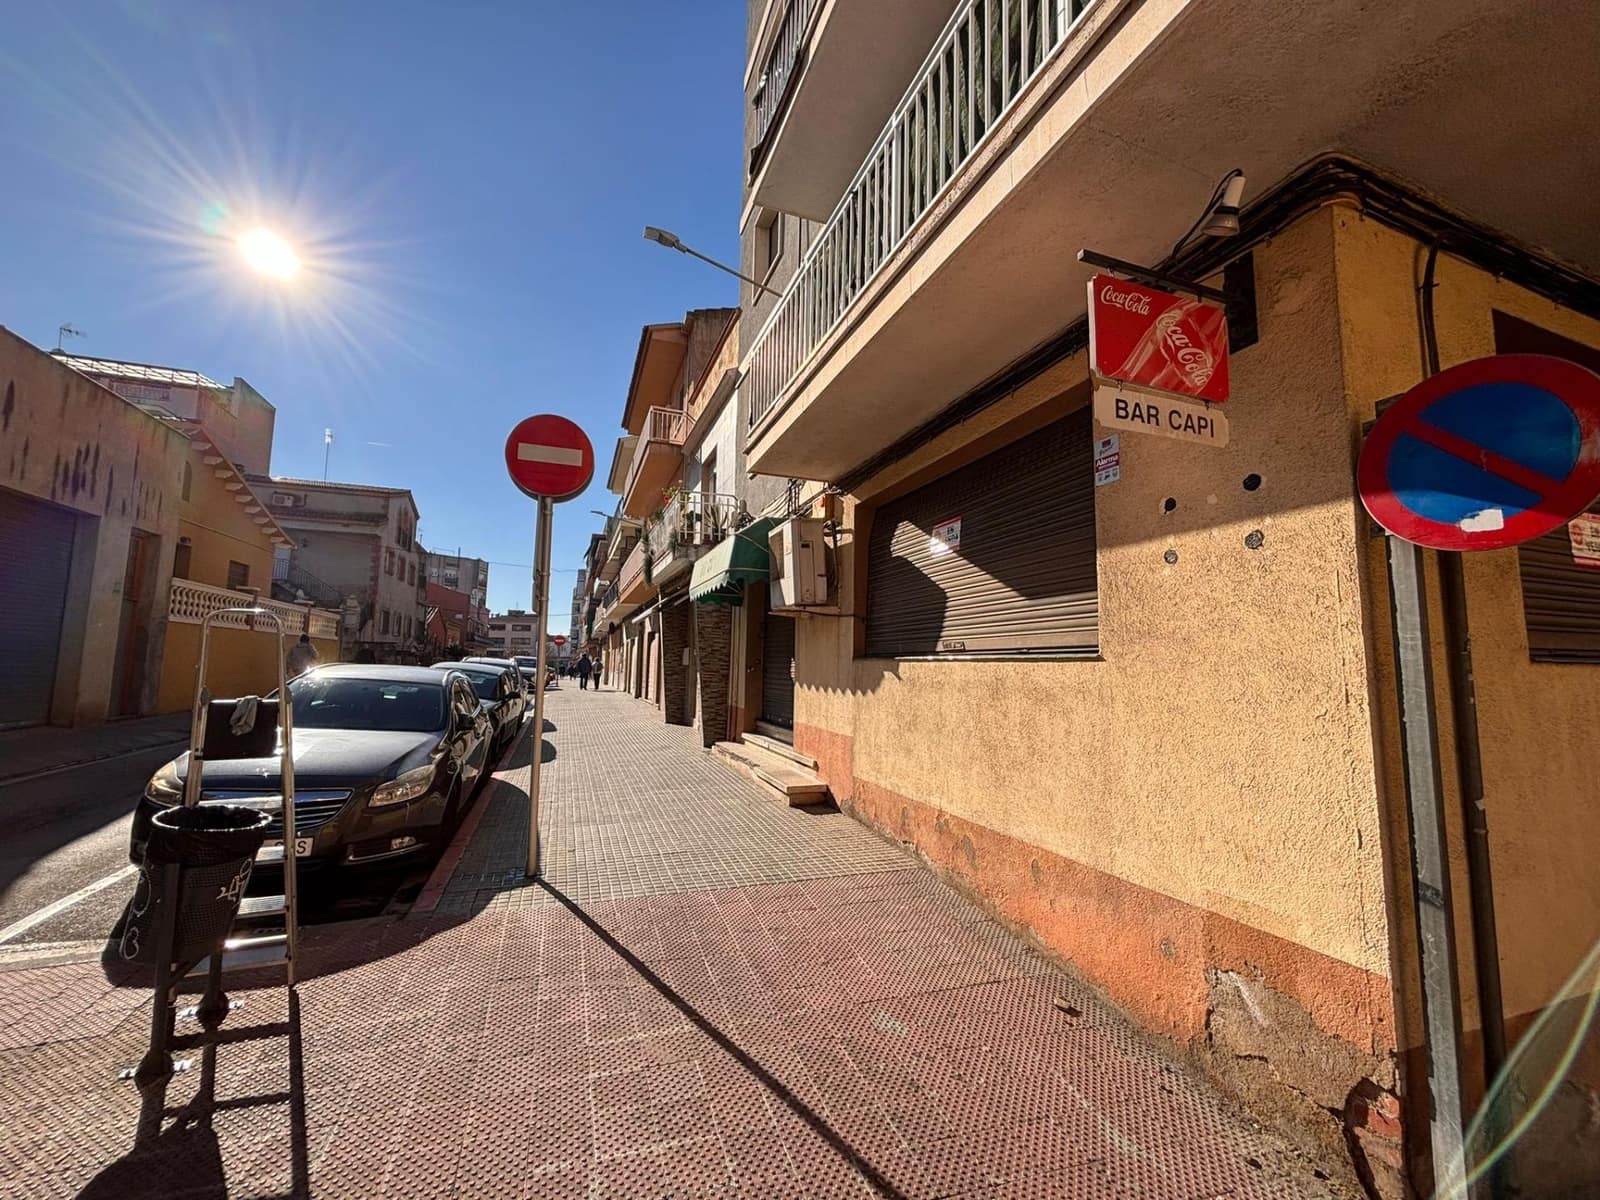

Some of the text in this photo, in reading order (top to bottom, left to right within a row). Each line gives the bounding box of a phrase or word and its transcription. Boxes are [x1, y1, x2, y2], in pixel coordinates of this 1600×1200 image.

[1101, 285, 1152, 316] Coca-Cola
[1115, 398, 1214, 438] BAR CAPI
